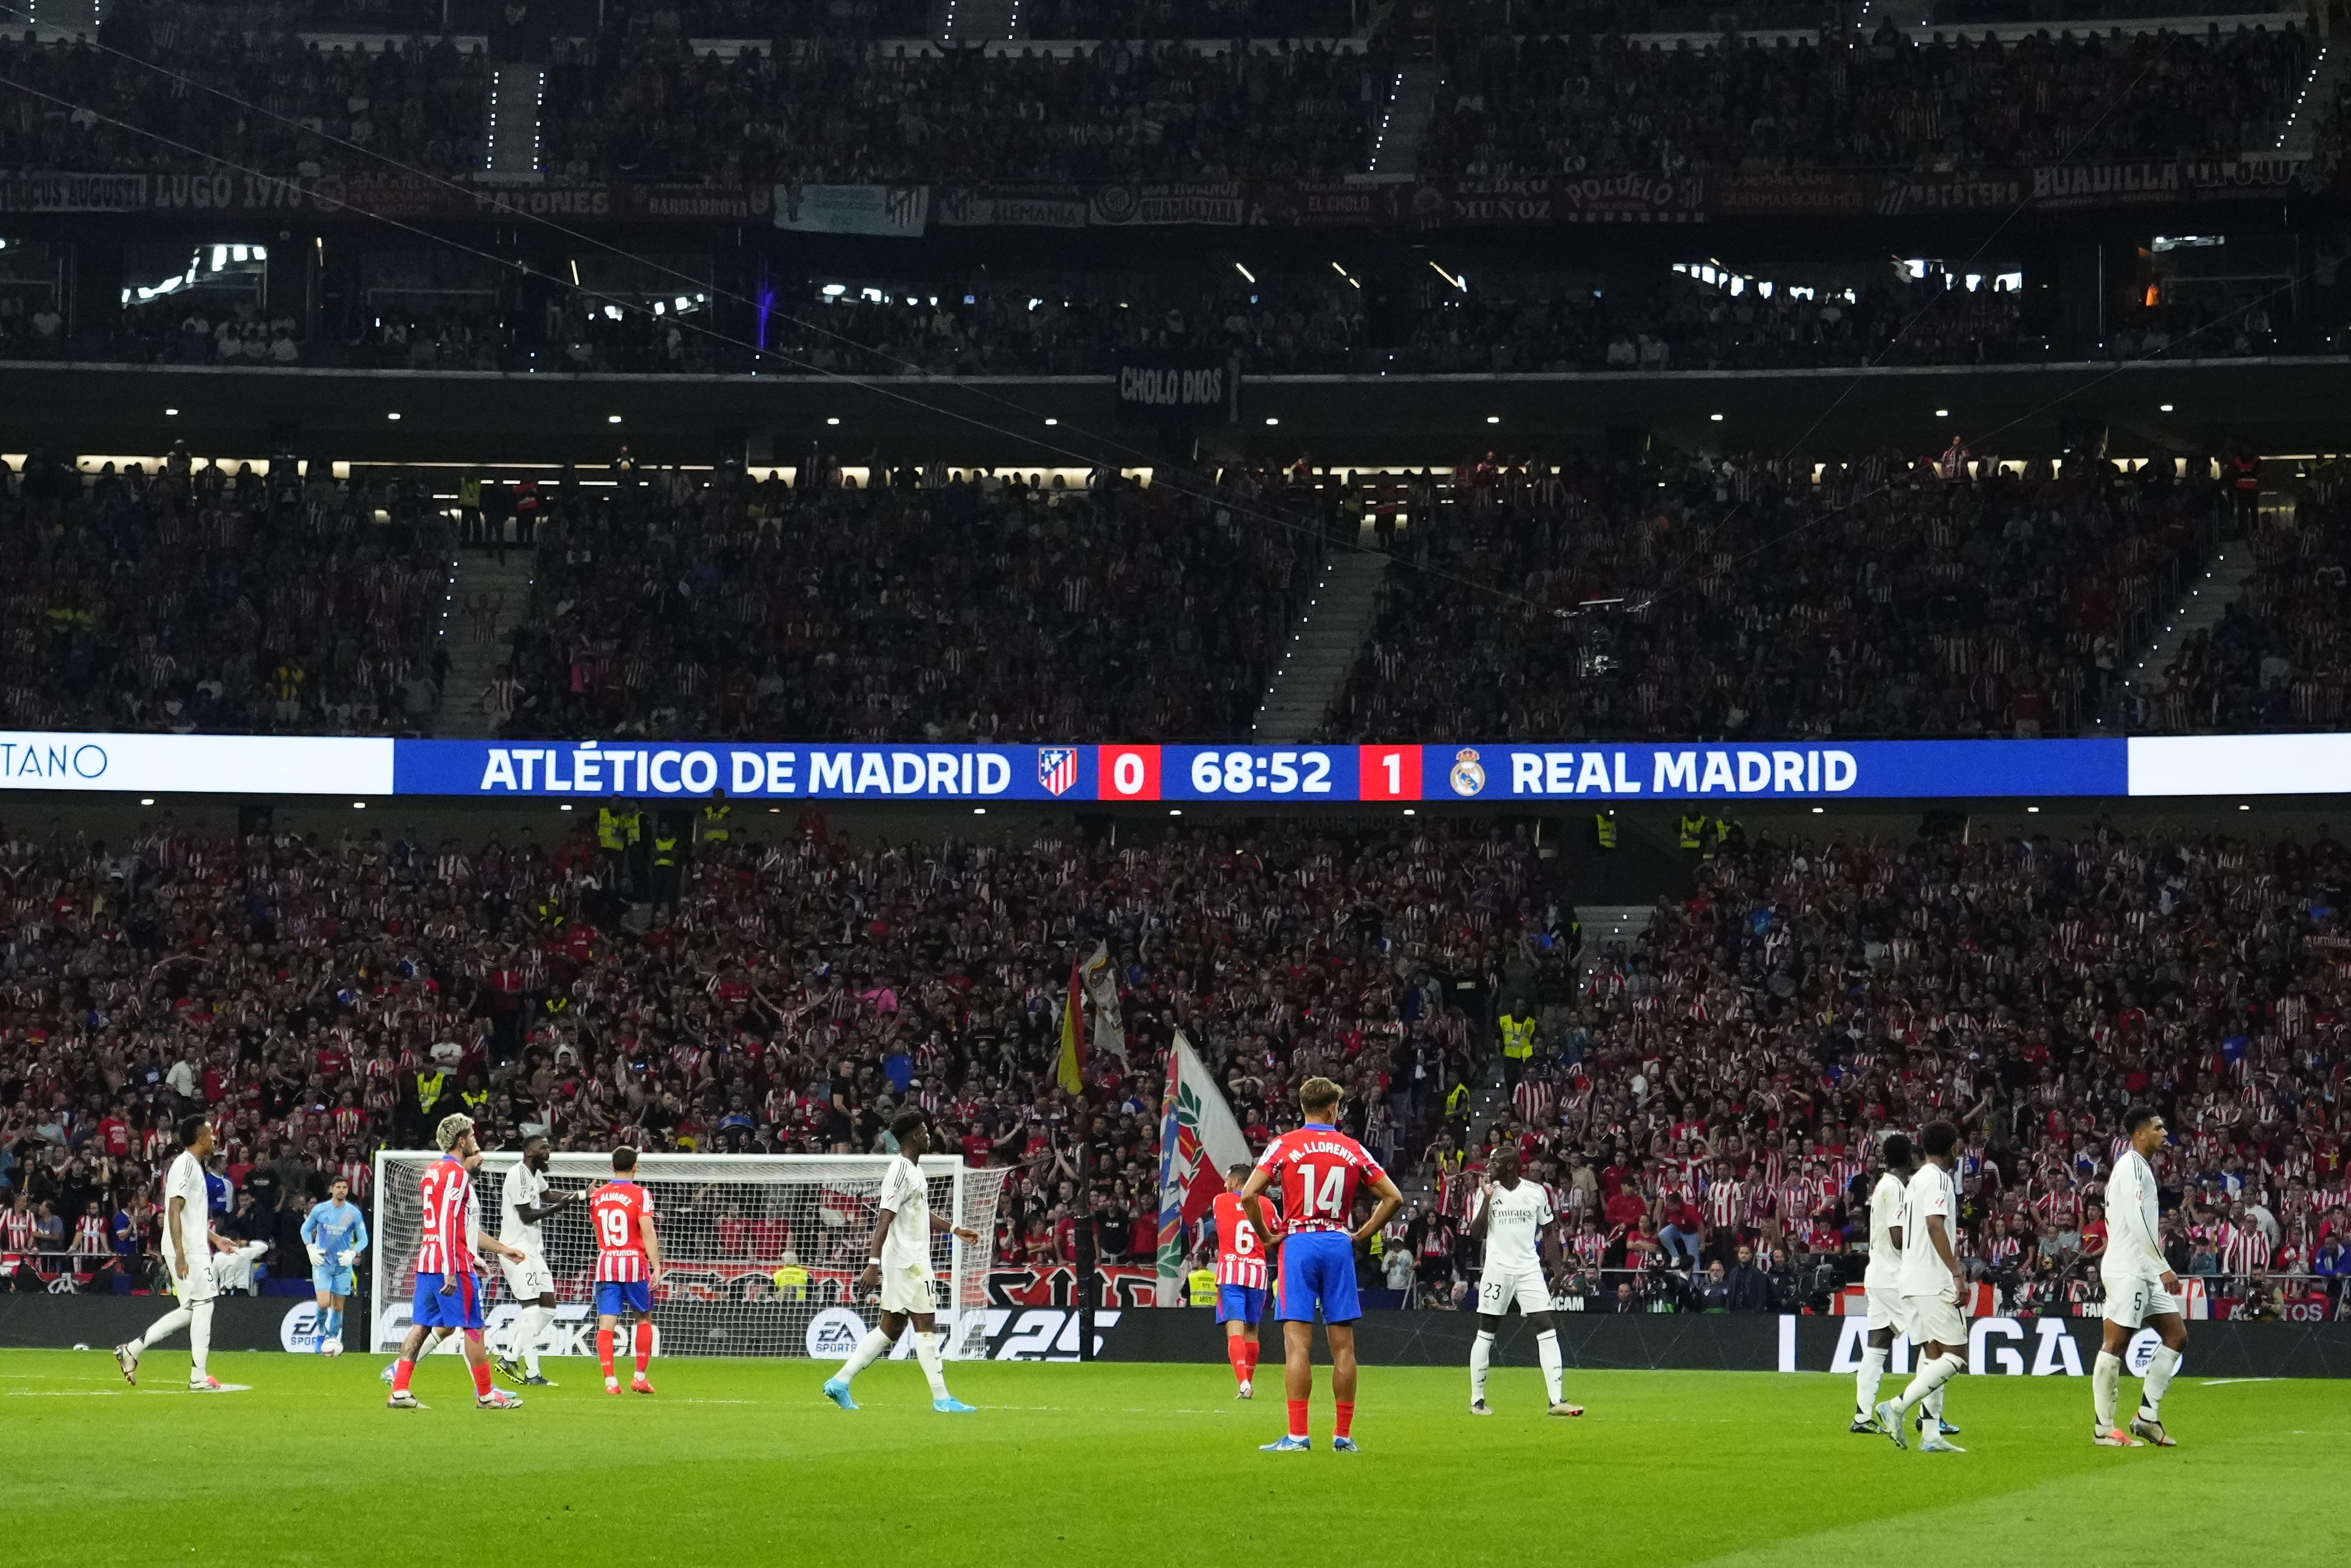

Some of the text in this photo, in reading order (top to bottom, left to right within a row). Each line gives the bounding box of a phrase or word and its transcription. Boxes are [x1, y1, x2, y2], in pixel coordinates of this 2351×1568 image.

[155, 175, 301, 208] LUGO 1978
[474, 191, 609, 214] PATONES
[1309, 196, 1323, 212] EL
[1453, 198, 1551, 220] MUÑOZ
[1121, 366, 1223, 405] CHOLO DIOS
[0, 744, 108, 778] TANO
[481, 741, 1011, 795] ATLÉTICO DE MADRID
[1114, 753, 1145, 795] 0
[1191, 751, 1332, 794] 68:52
[1382, 753, 1401, 795] 1
[1511, 750, 1858, 794] REAL MADRID
[1288, 1141, 1359, 1167] M. LLORENTE
[422, 1185, 437, 1229] 5
[1296, 1164, 1346, 1220] 14
[597, 1208, 629, 1247] 19
[1492, 1209, 1532, 1218] Emirates
[1235, 1220, 1254, 1256] 6
[205, 1268, 213, 1282] 3
[1483, 1282, 1501, 1300] 23
[2134, 1292, 2142, 1311] 5
[815, 1343, 857, 1353] SPORTS
[817, 1322, 856, 1343] EA
[994, 1309, 1122, 1361] 25
[1778, 1315, 2084, 1376] LALGA
